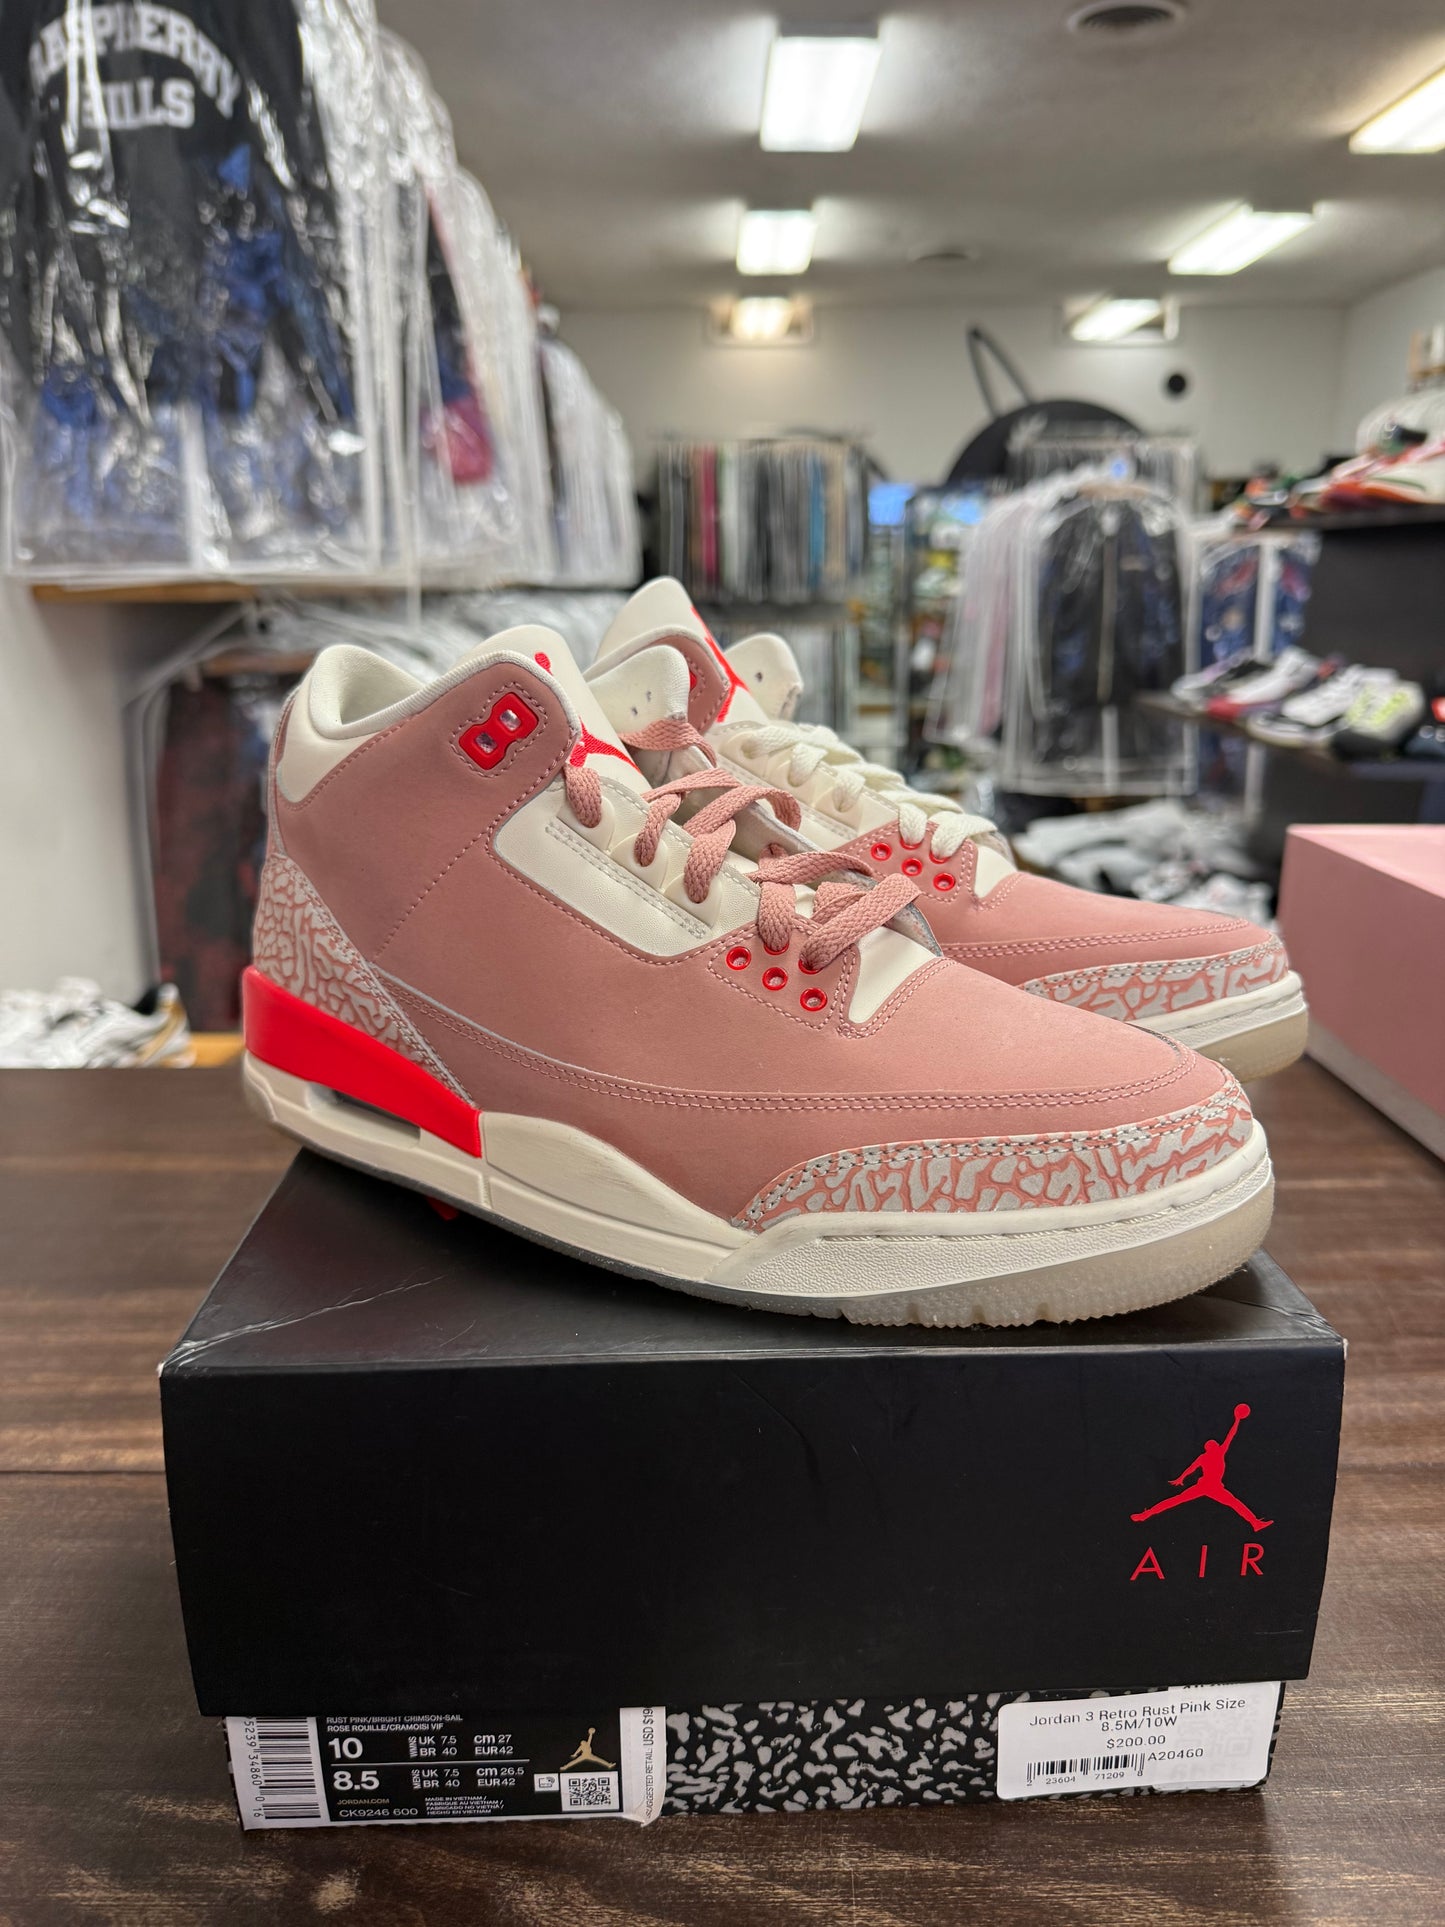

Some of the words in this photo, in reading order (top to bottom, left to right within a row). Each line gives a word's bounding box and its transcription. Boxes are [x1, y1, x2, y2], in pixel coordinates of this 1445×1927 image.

[28, 0, 242, 119] RAPERRY
[1129, 1543, 1265, 1581] AIR
[326, 1716, 348, 1724] RUST
[350, 1715, 402, 1723] PINK/BRIGHT
[404, 1714, 463, 1722] CRIMSON-SAIL
[642, 1707, 654, 1725] $19
[1029, 1712, 1081, 1727] Jordan
[1085, 1711, 1094, 1722] 3
[1099, 1708, 1138, 1722] Retro
[1142, 1704, 1176, 1717] Rust
[1180, 1700, 1211, 1715] Pink
[1216, 1697, 1246, 1710] Size
[352, 1723, 430, 1732] ROUILLE/CRAMOISI
[431, 1722, 444, 1730] VIF
[1101, 1715, 1178, 1732] 8.5M/10W
[418, 1736, 436, 1745] UK
[441, 1735, 457, 1744] 7.5
[474, 1734, 496, 1744] cm
[498, 1734, 512, 1743] 27
[642, 1726, 654, 1746] USD
[1106, 1734, 1166, 1750] $200.00
[328, 1737, 364, 1759] 10
[408, 1735, 418, 1758] WMNS
[420, 1747, 437, 1757] BR
[442, 1747, 458, 1756] 40
[475, 1746, 498, 1755] EUR
[499, 1745, 514, 1754] 42
[1148, 1748, 1204, 1762] A20460
[248, 1753, 263, 1786] 34860
[421, 1769, 439, 1778] UK
[443, 1768, 460, 1777] 7.5
[476, 1767, 498, 1776] cm
[500, 1766, 525, 1776] 26.5
[333, 1770, 380, 1791] 8.5
[411, 1769, 421, 1790] MENS
[423, 1780, 440, 1788] BR
[445, 1779, 460, 1788] 40
[477, 1778, 501, 1787] EUR
[501, 1777, 516, 1786] 42
[1026, 1779, 1033, 1787] 2
[1045, 1776, 1076, 1785] 23604
[1095, 1771, 1125, 1780] 71209
[336, 1798, 390, 1806] JORDAN.COM
[252, 1807, 264, 1818] 16
[339, 1808, 390, 1818] CK9246
[393, 1808, 419, 1816] 600
